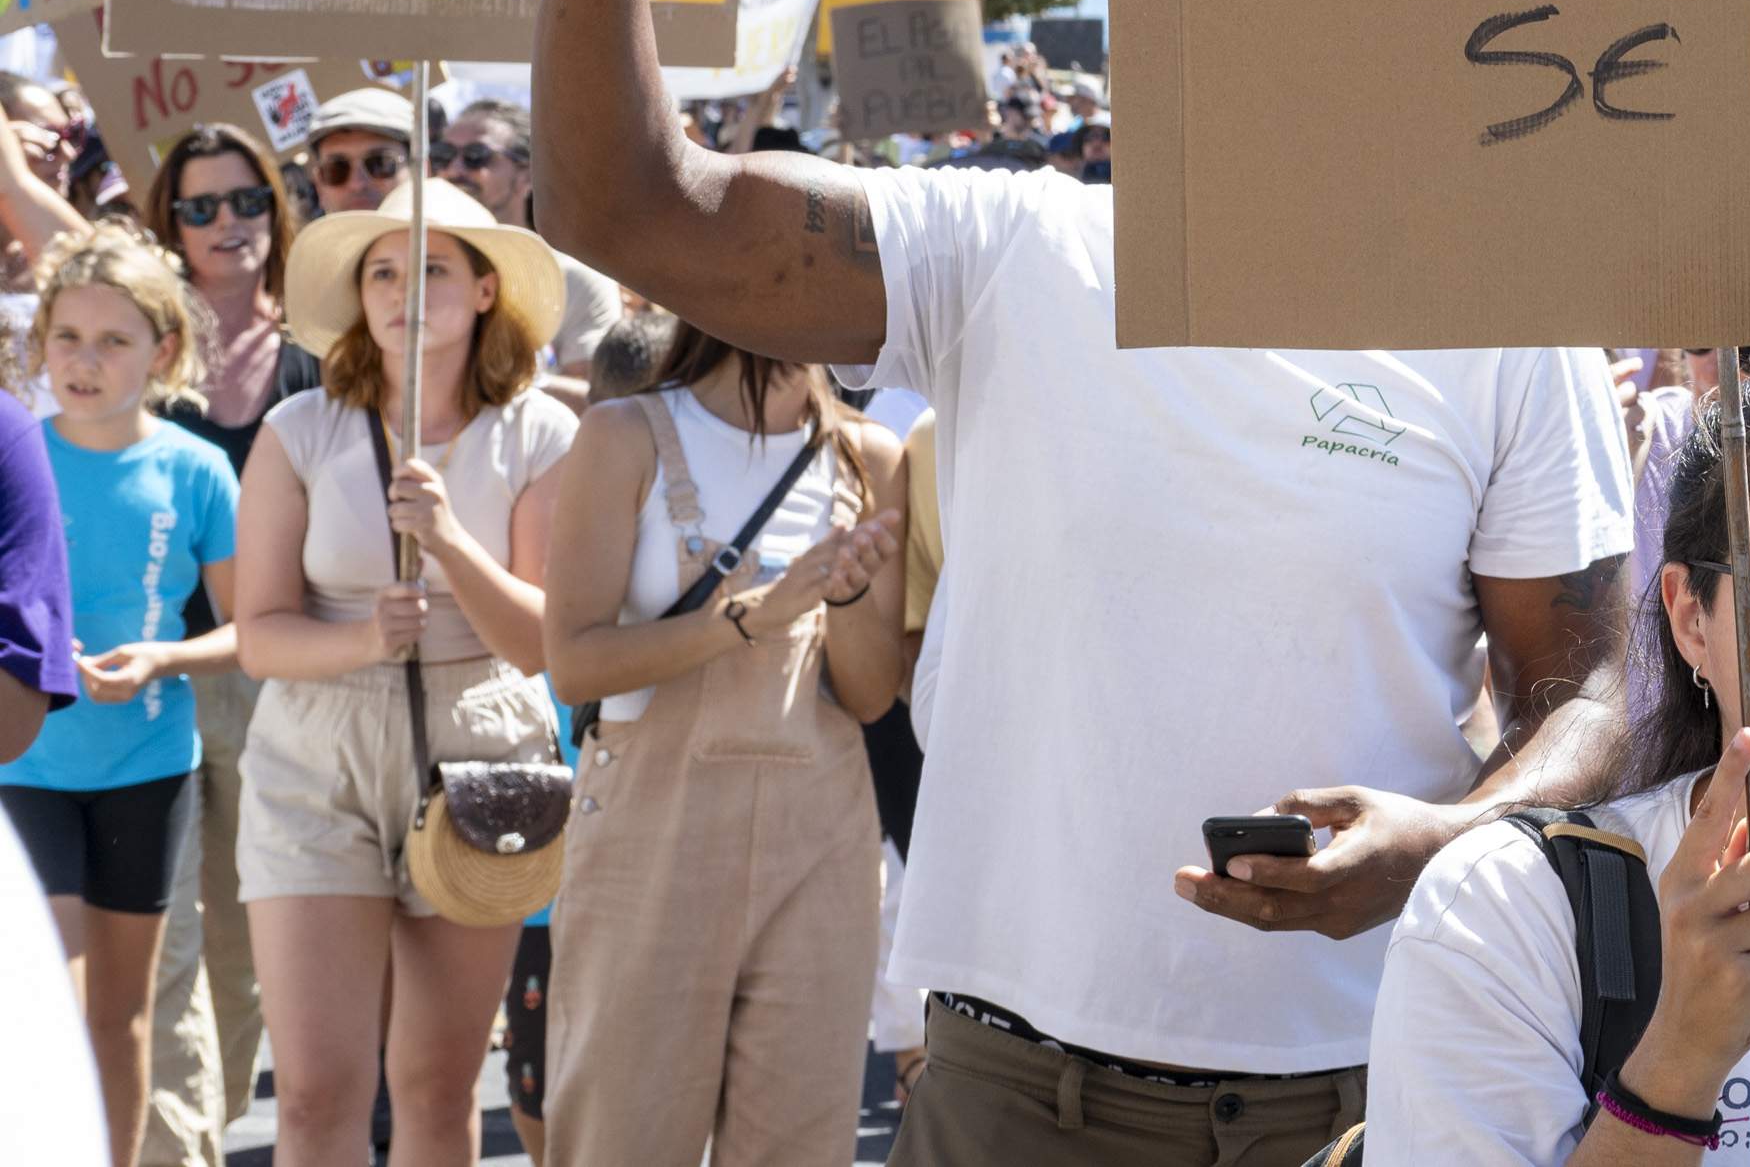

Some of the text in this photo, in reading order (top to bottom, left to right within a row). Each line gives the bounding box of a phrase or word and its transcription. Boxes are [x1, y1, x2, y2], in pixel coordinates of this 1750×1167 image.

[132, 58, 198, 131] NO
[1465, 4, 1681, 147] SE
[1301, 435, 1400, 466] Papacría
